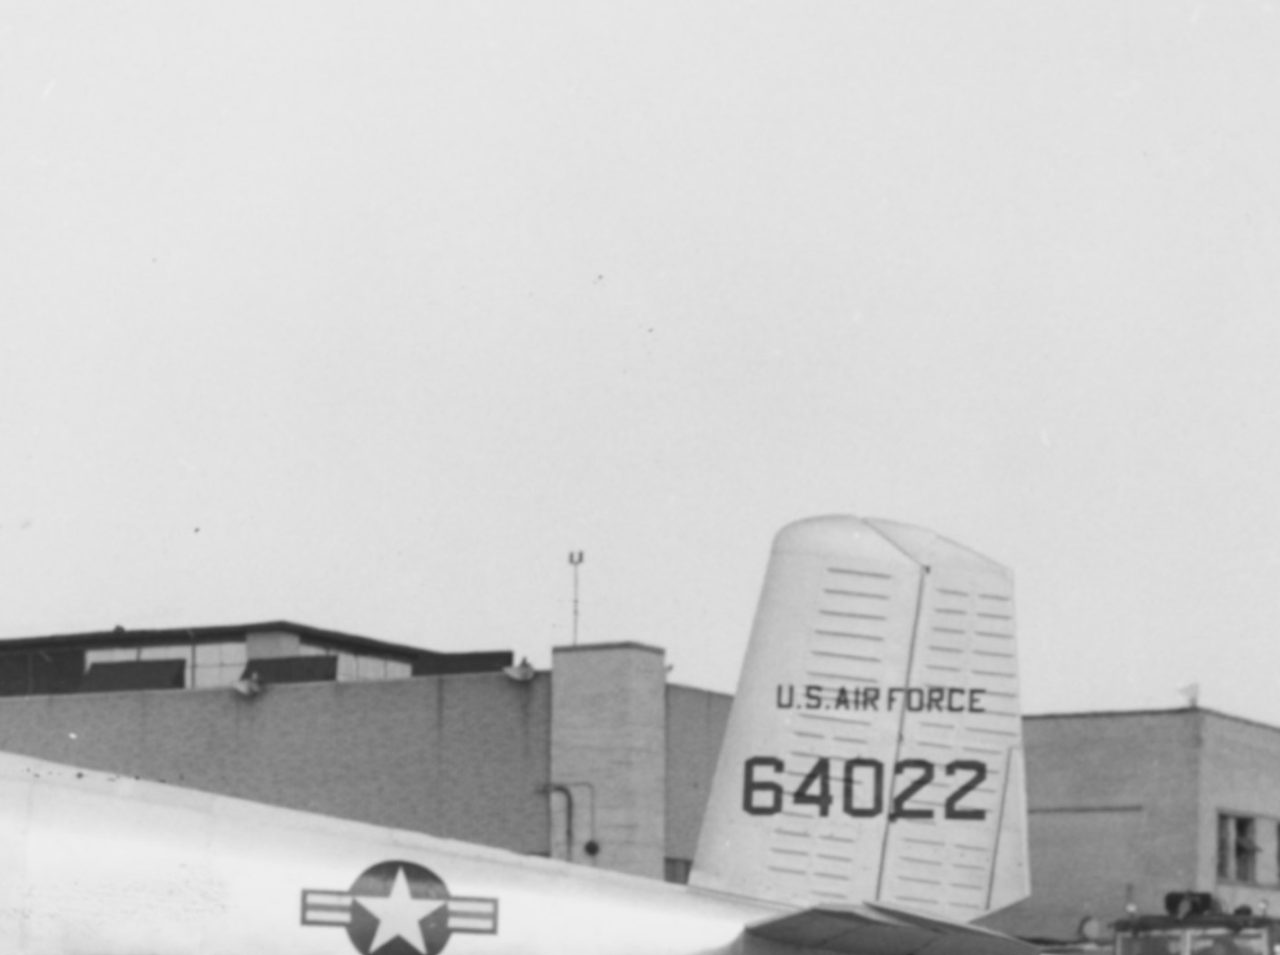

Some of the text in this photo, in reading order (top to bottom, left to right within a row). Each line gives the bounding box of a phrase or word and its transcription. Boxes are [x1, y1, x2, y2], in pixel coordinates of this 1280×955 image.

[834, 686, 880, 711] AIR
[888, 687, 987, 713] FORCE
[742, 755, 988, 821] 64022
